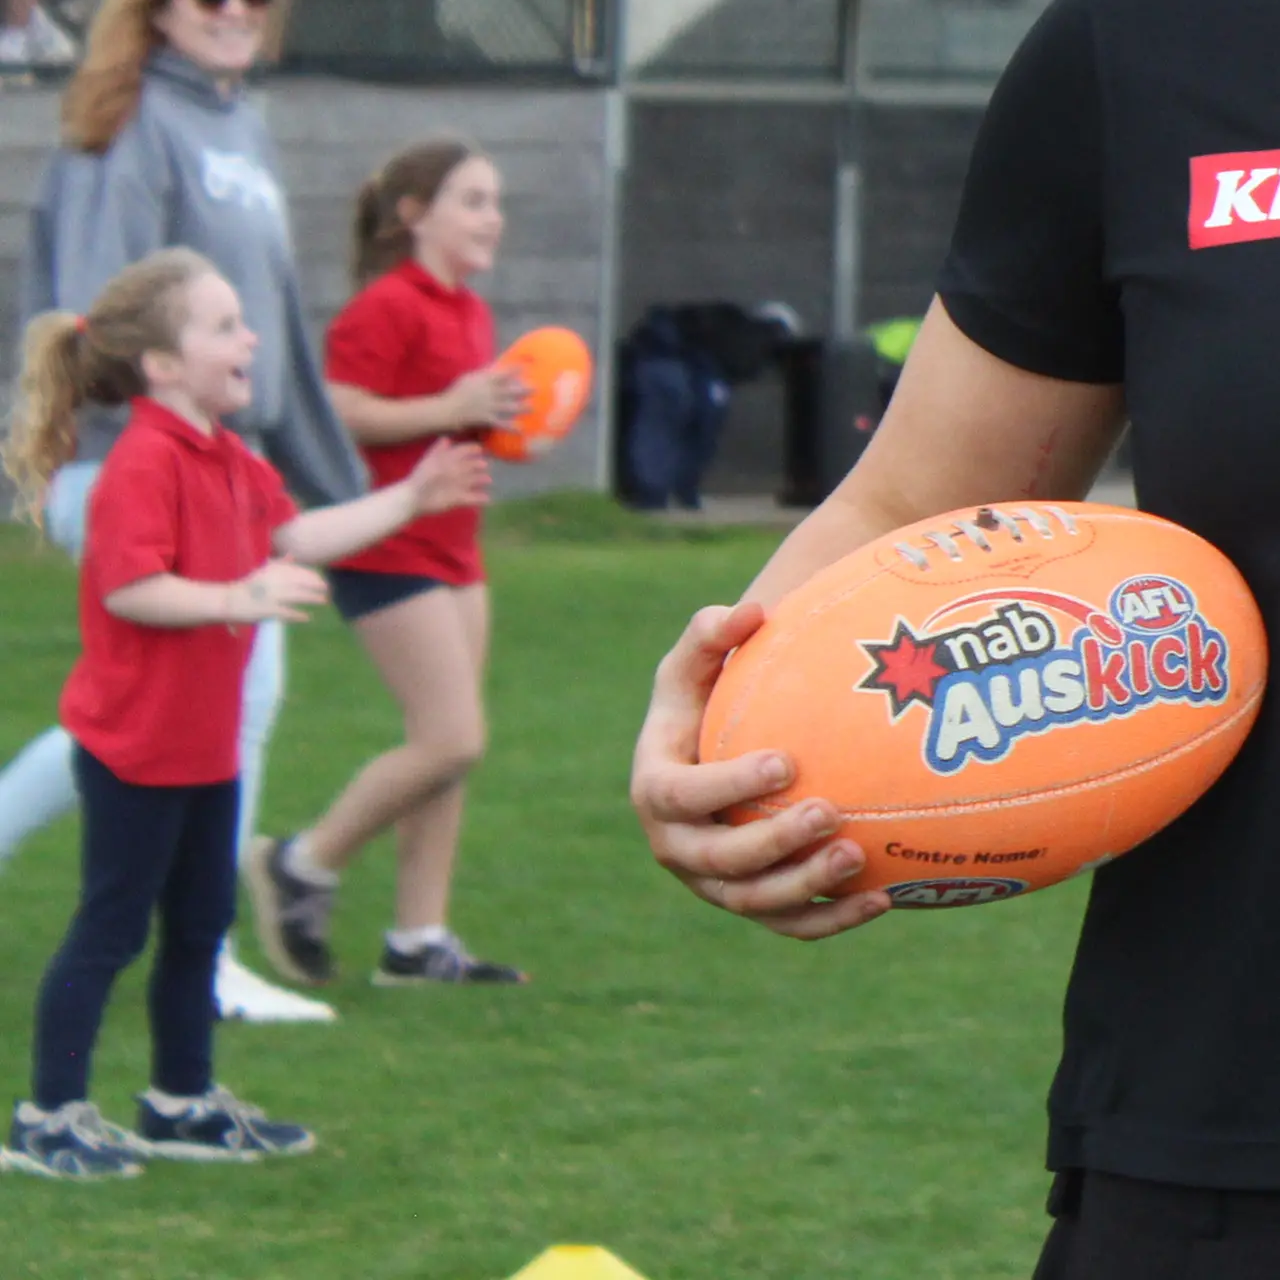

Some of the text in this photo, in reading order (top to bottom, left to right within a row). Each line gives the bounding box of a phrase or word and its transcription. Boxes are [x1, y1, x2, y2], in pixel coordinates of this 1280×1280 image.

[1121, 586, 1190, 624] AFL
[945, 610, 1048, 669] nab
[886, 842, 966, 865] Centre
[894, 886, 1006, 904] AFL
